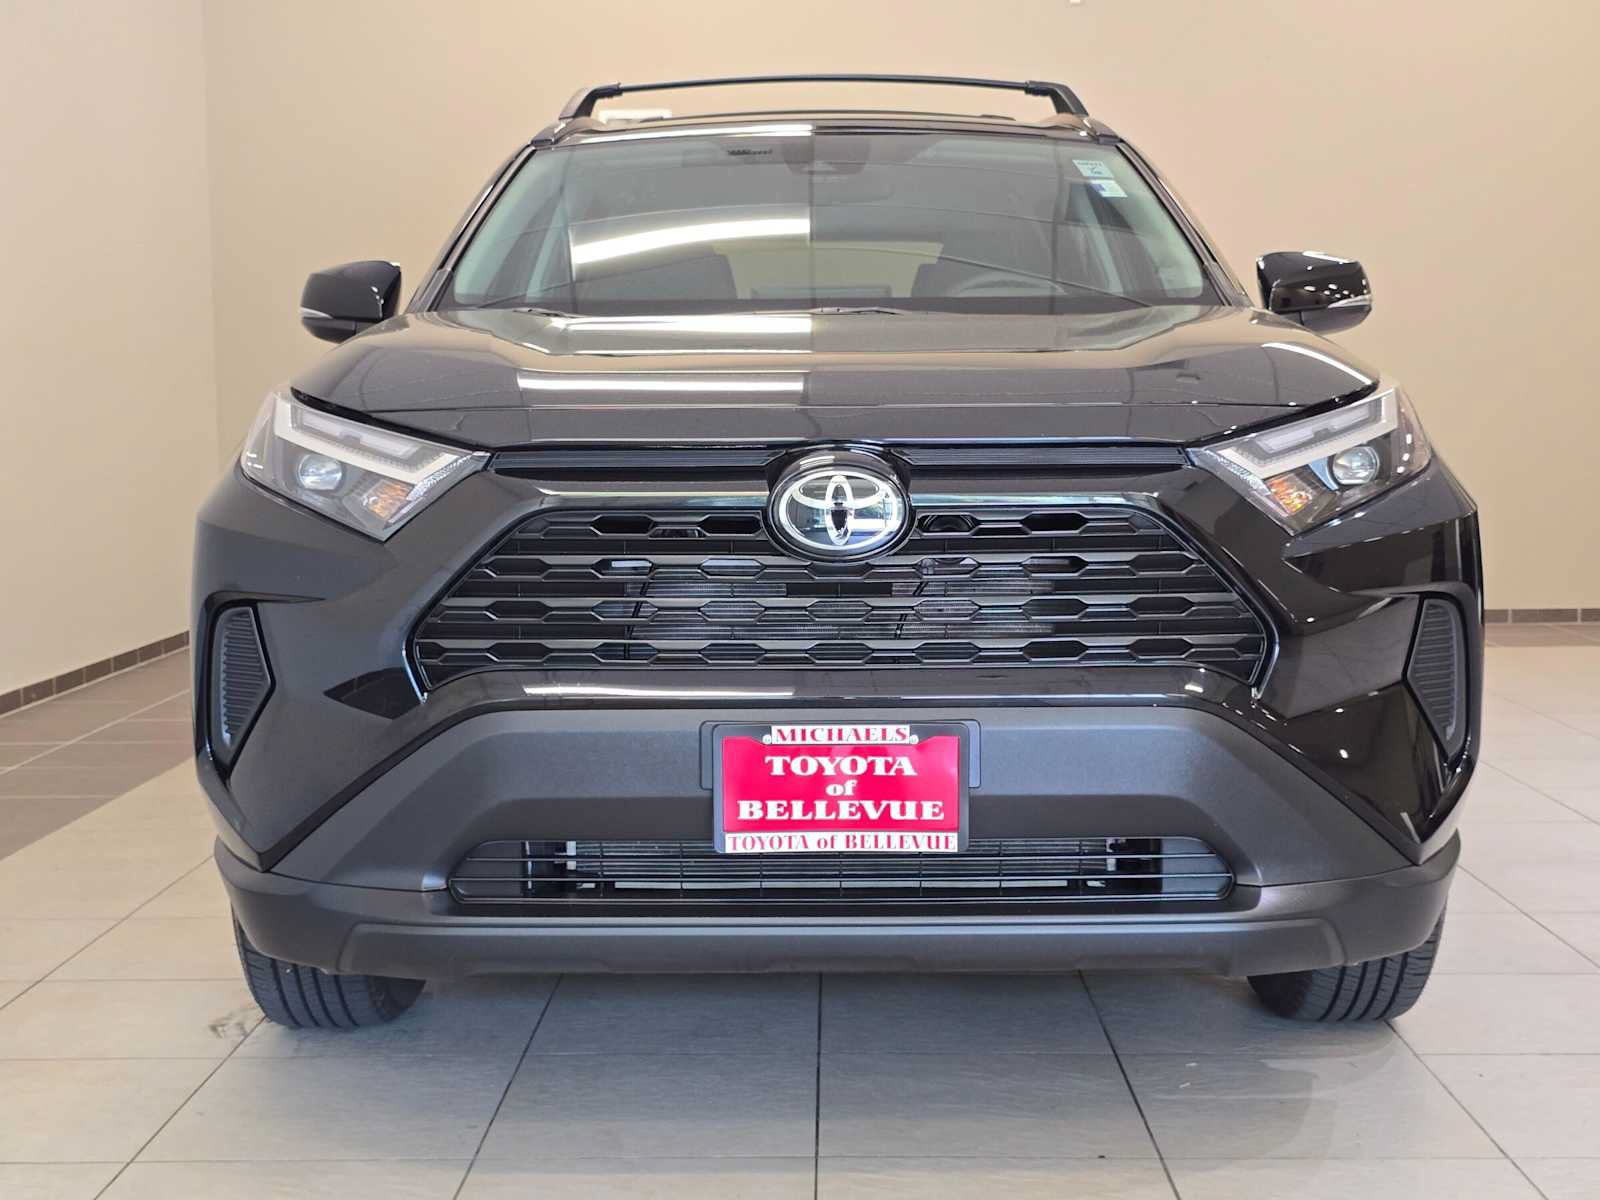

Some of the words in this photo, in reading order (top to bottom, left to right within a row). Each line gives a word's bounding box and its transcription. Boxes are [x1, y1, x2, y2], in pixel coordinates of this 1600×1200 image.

[775, 727, 909, 743] MICHAELS
[765, 756, 918, 776] TOYOTA
[825, 779, 858, 797] of
[737, 800, 945, 821] BELLEVUE
[728, 835, 810, 851] TOYOTA
[817, 834, 839, 850] of
[845, 834, 957, 851] BELLEVUE
